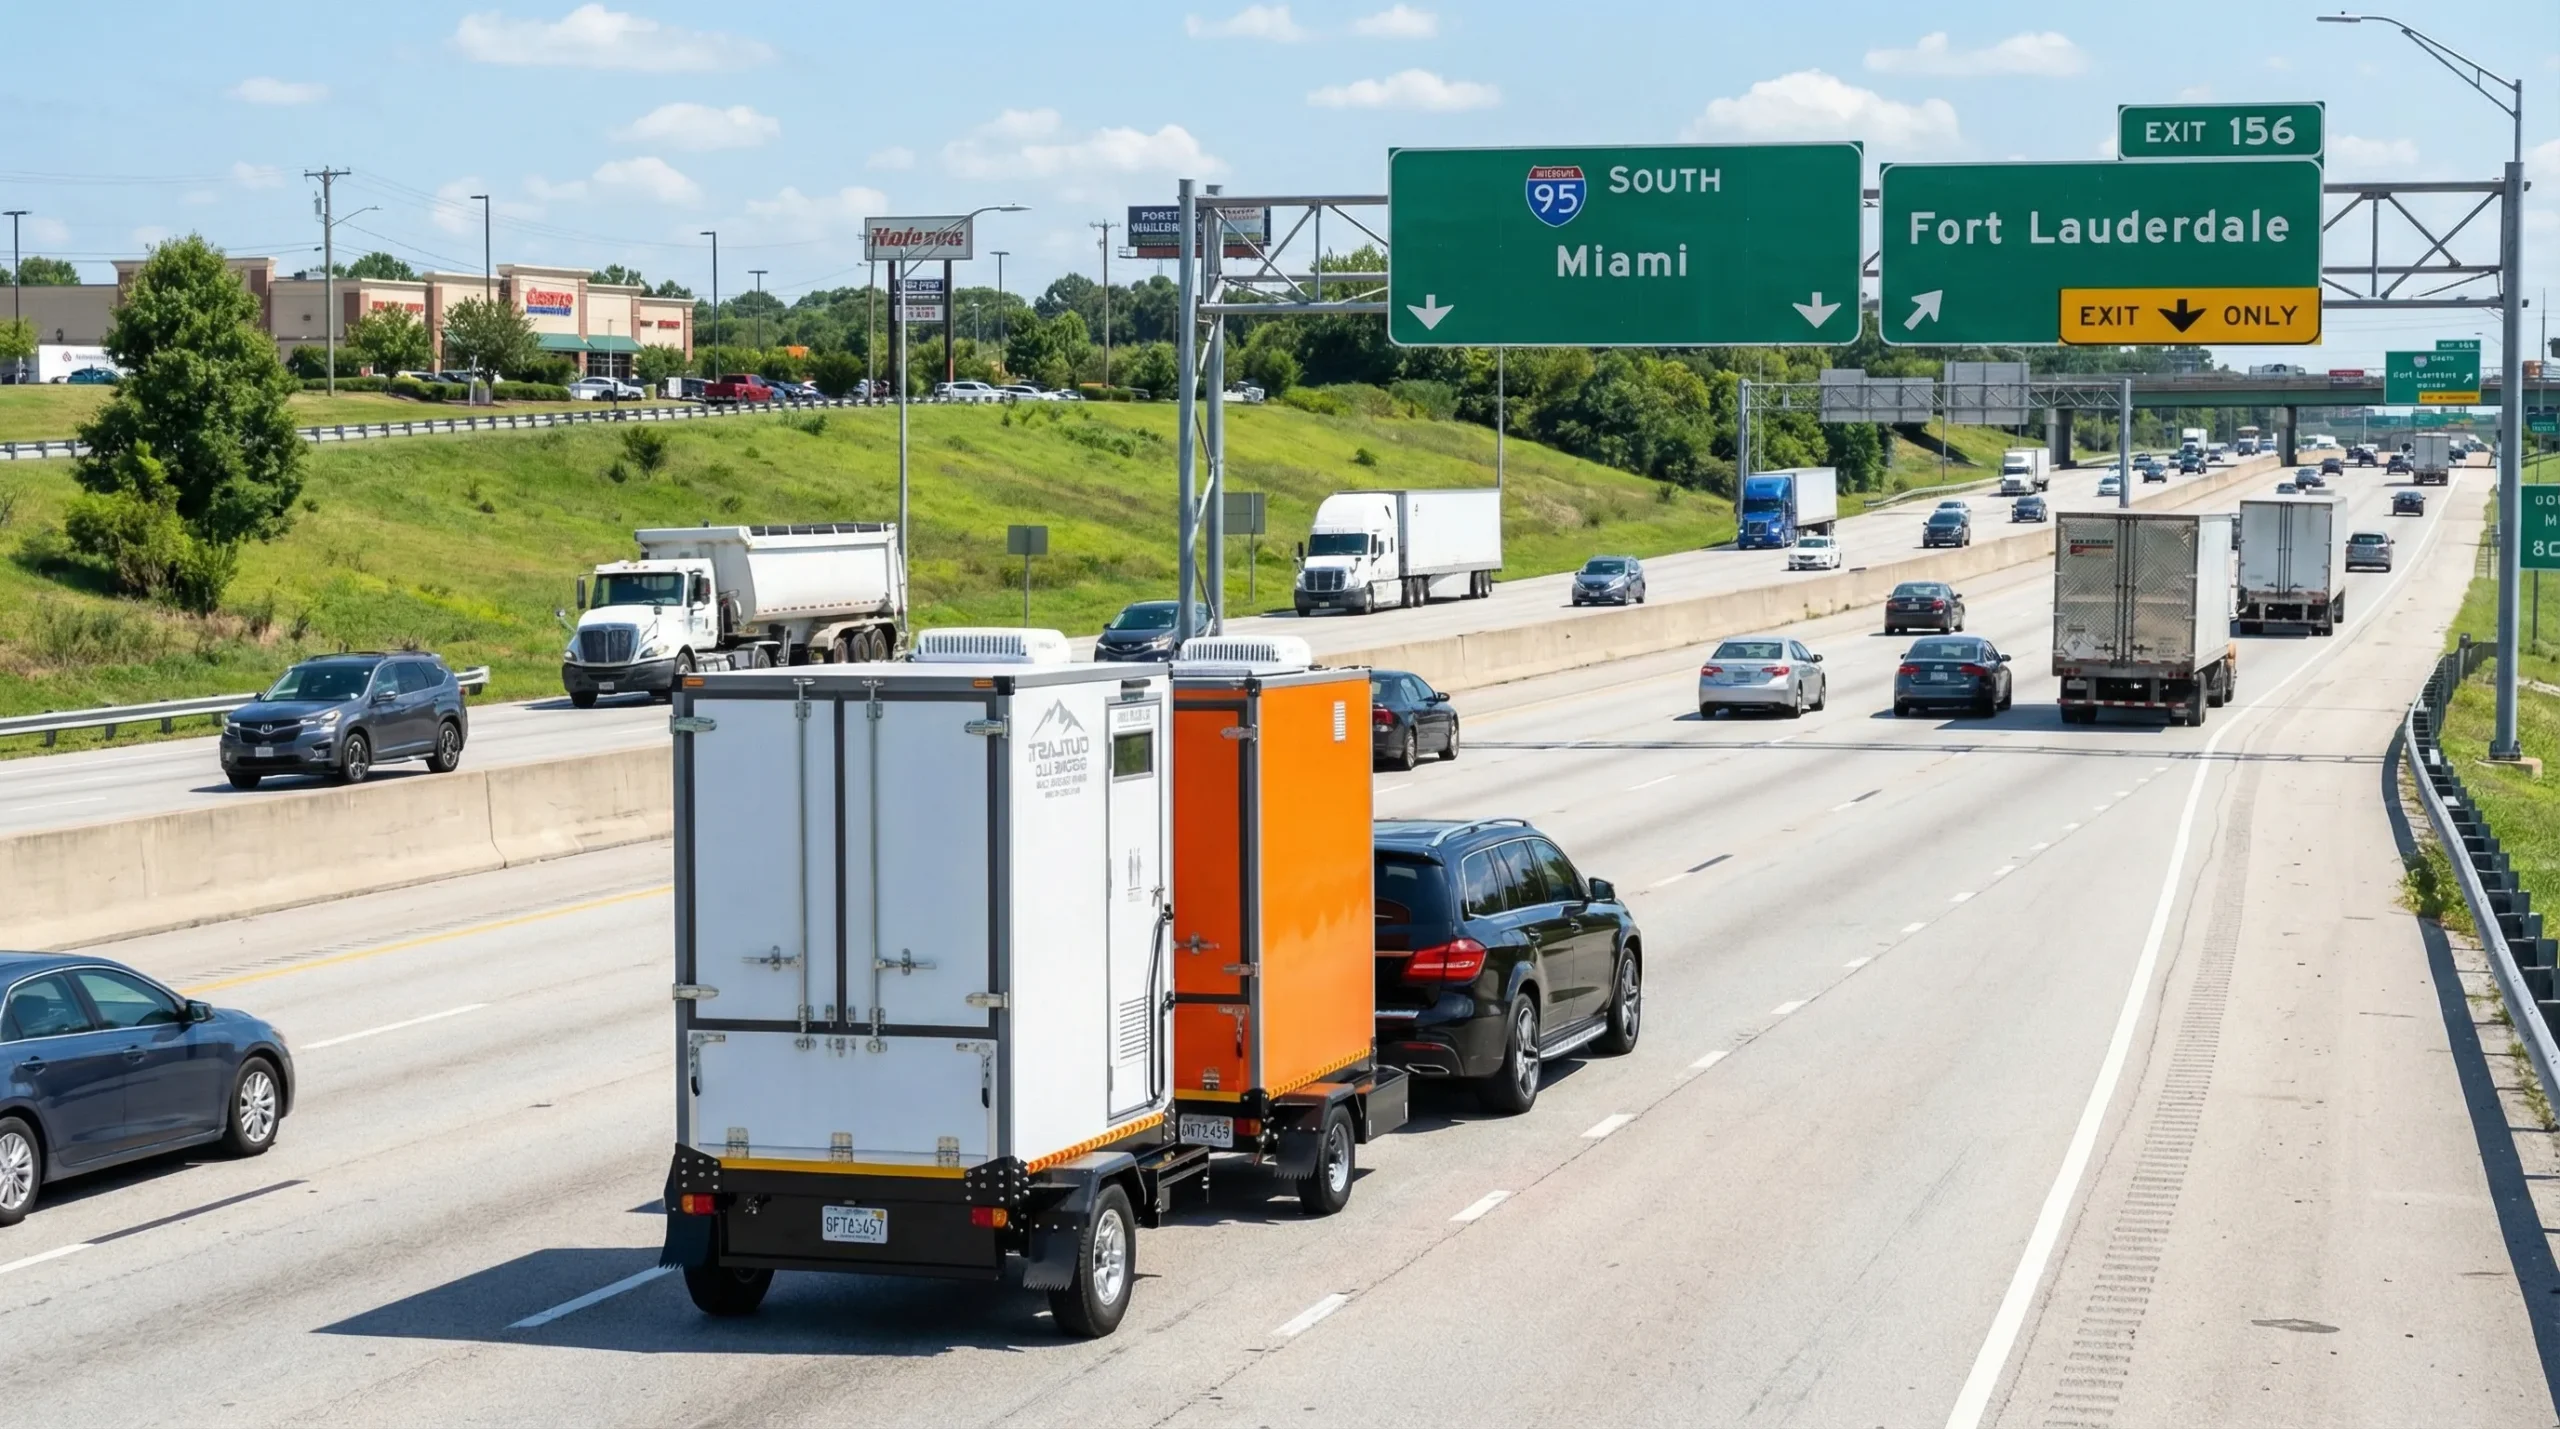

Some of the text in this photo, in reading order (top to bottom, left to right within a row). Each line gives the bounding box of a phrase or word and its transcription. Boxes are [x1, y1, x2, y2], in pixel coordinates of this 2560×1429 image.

[2145, 115, 2295, 146] EXIT 156
[1609, 165, 1721, 194] SOUTH
[1534, 183, 1578, 214] 95
[1910, 208, 2290, 245] Fort Lauderdale
[1557, 243, 1687, 277] Miami
[2080, 305, 2299, 326] EXIT ONLY
